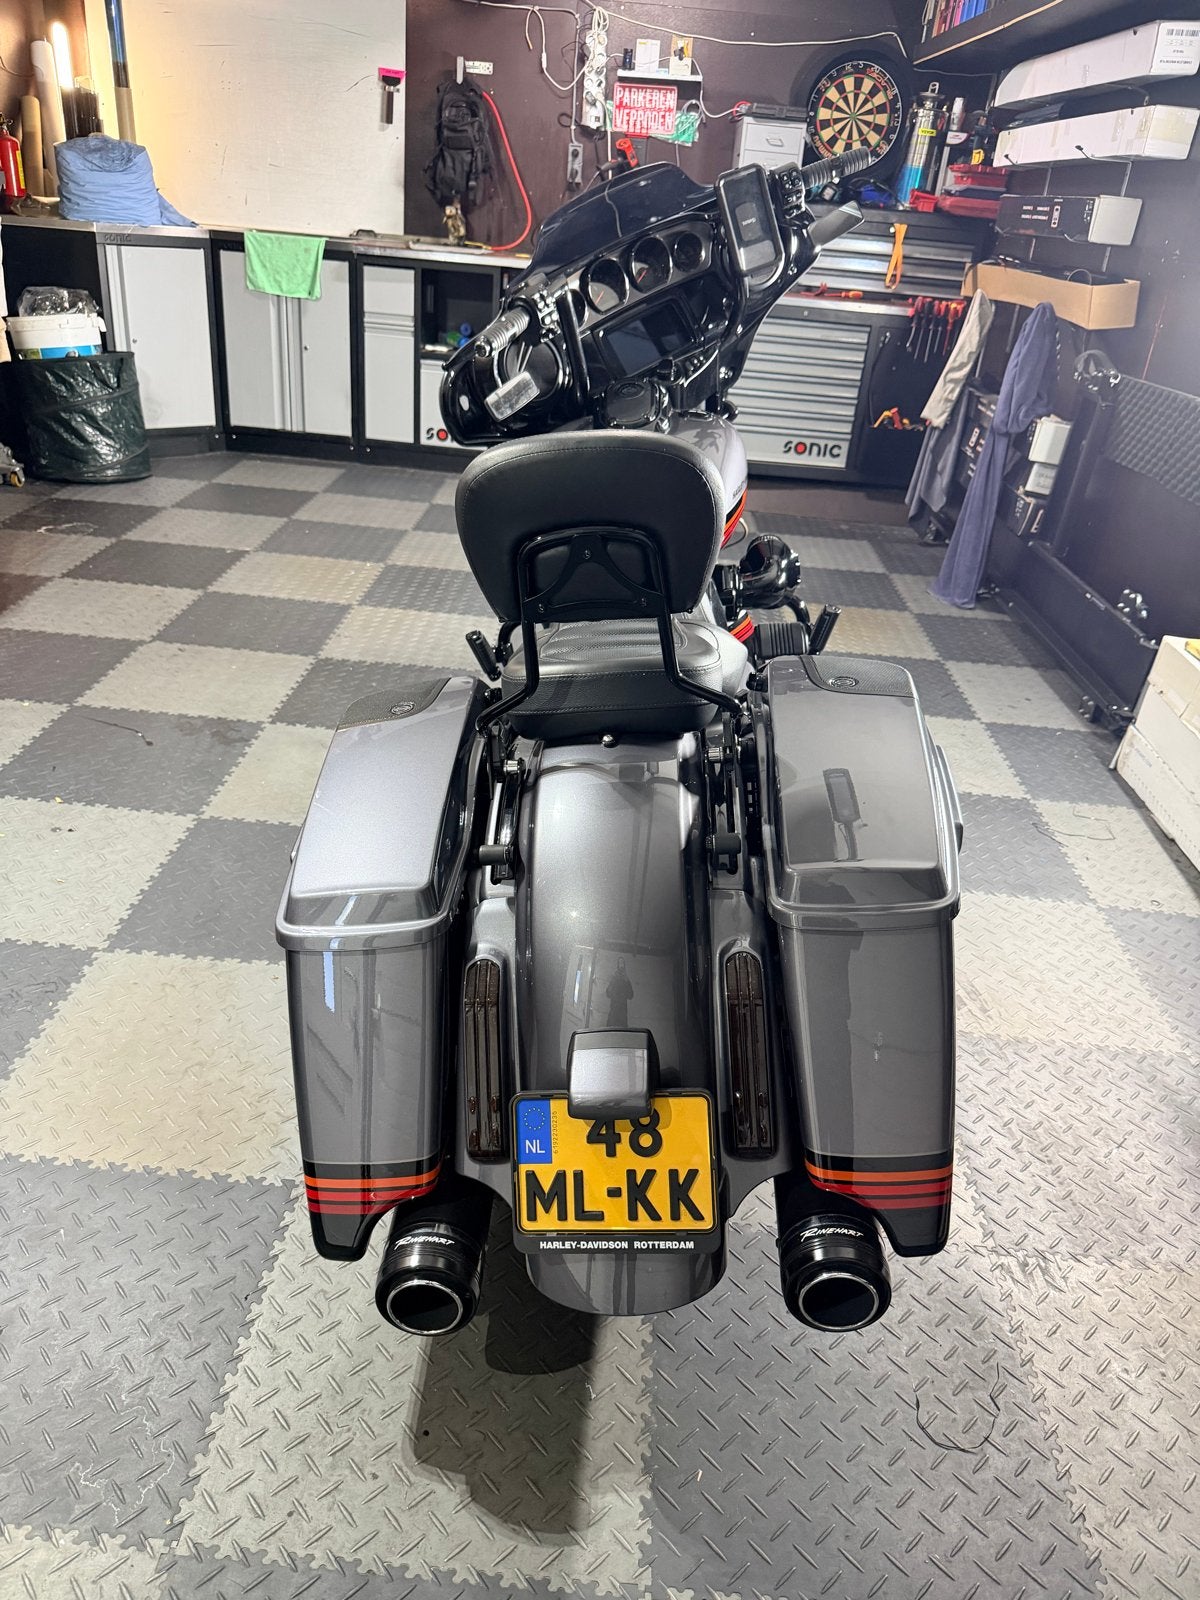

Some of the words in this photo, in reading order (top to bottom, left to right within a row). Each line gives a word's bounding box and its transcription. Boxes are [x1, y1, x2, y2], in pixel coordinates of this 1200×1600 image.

[615, 86, 675, 109] PARKEREN
[586, 1107, 663, 1158] 48
[525, 1140, 546, 1154] NL
[525, 1169, 705, 1222] ML-KK
[539, 1241, 629, 1249] HARLEY-DAVIDSON
[633, 1241, 695, 1249] ROTTERDAM
